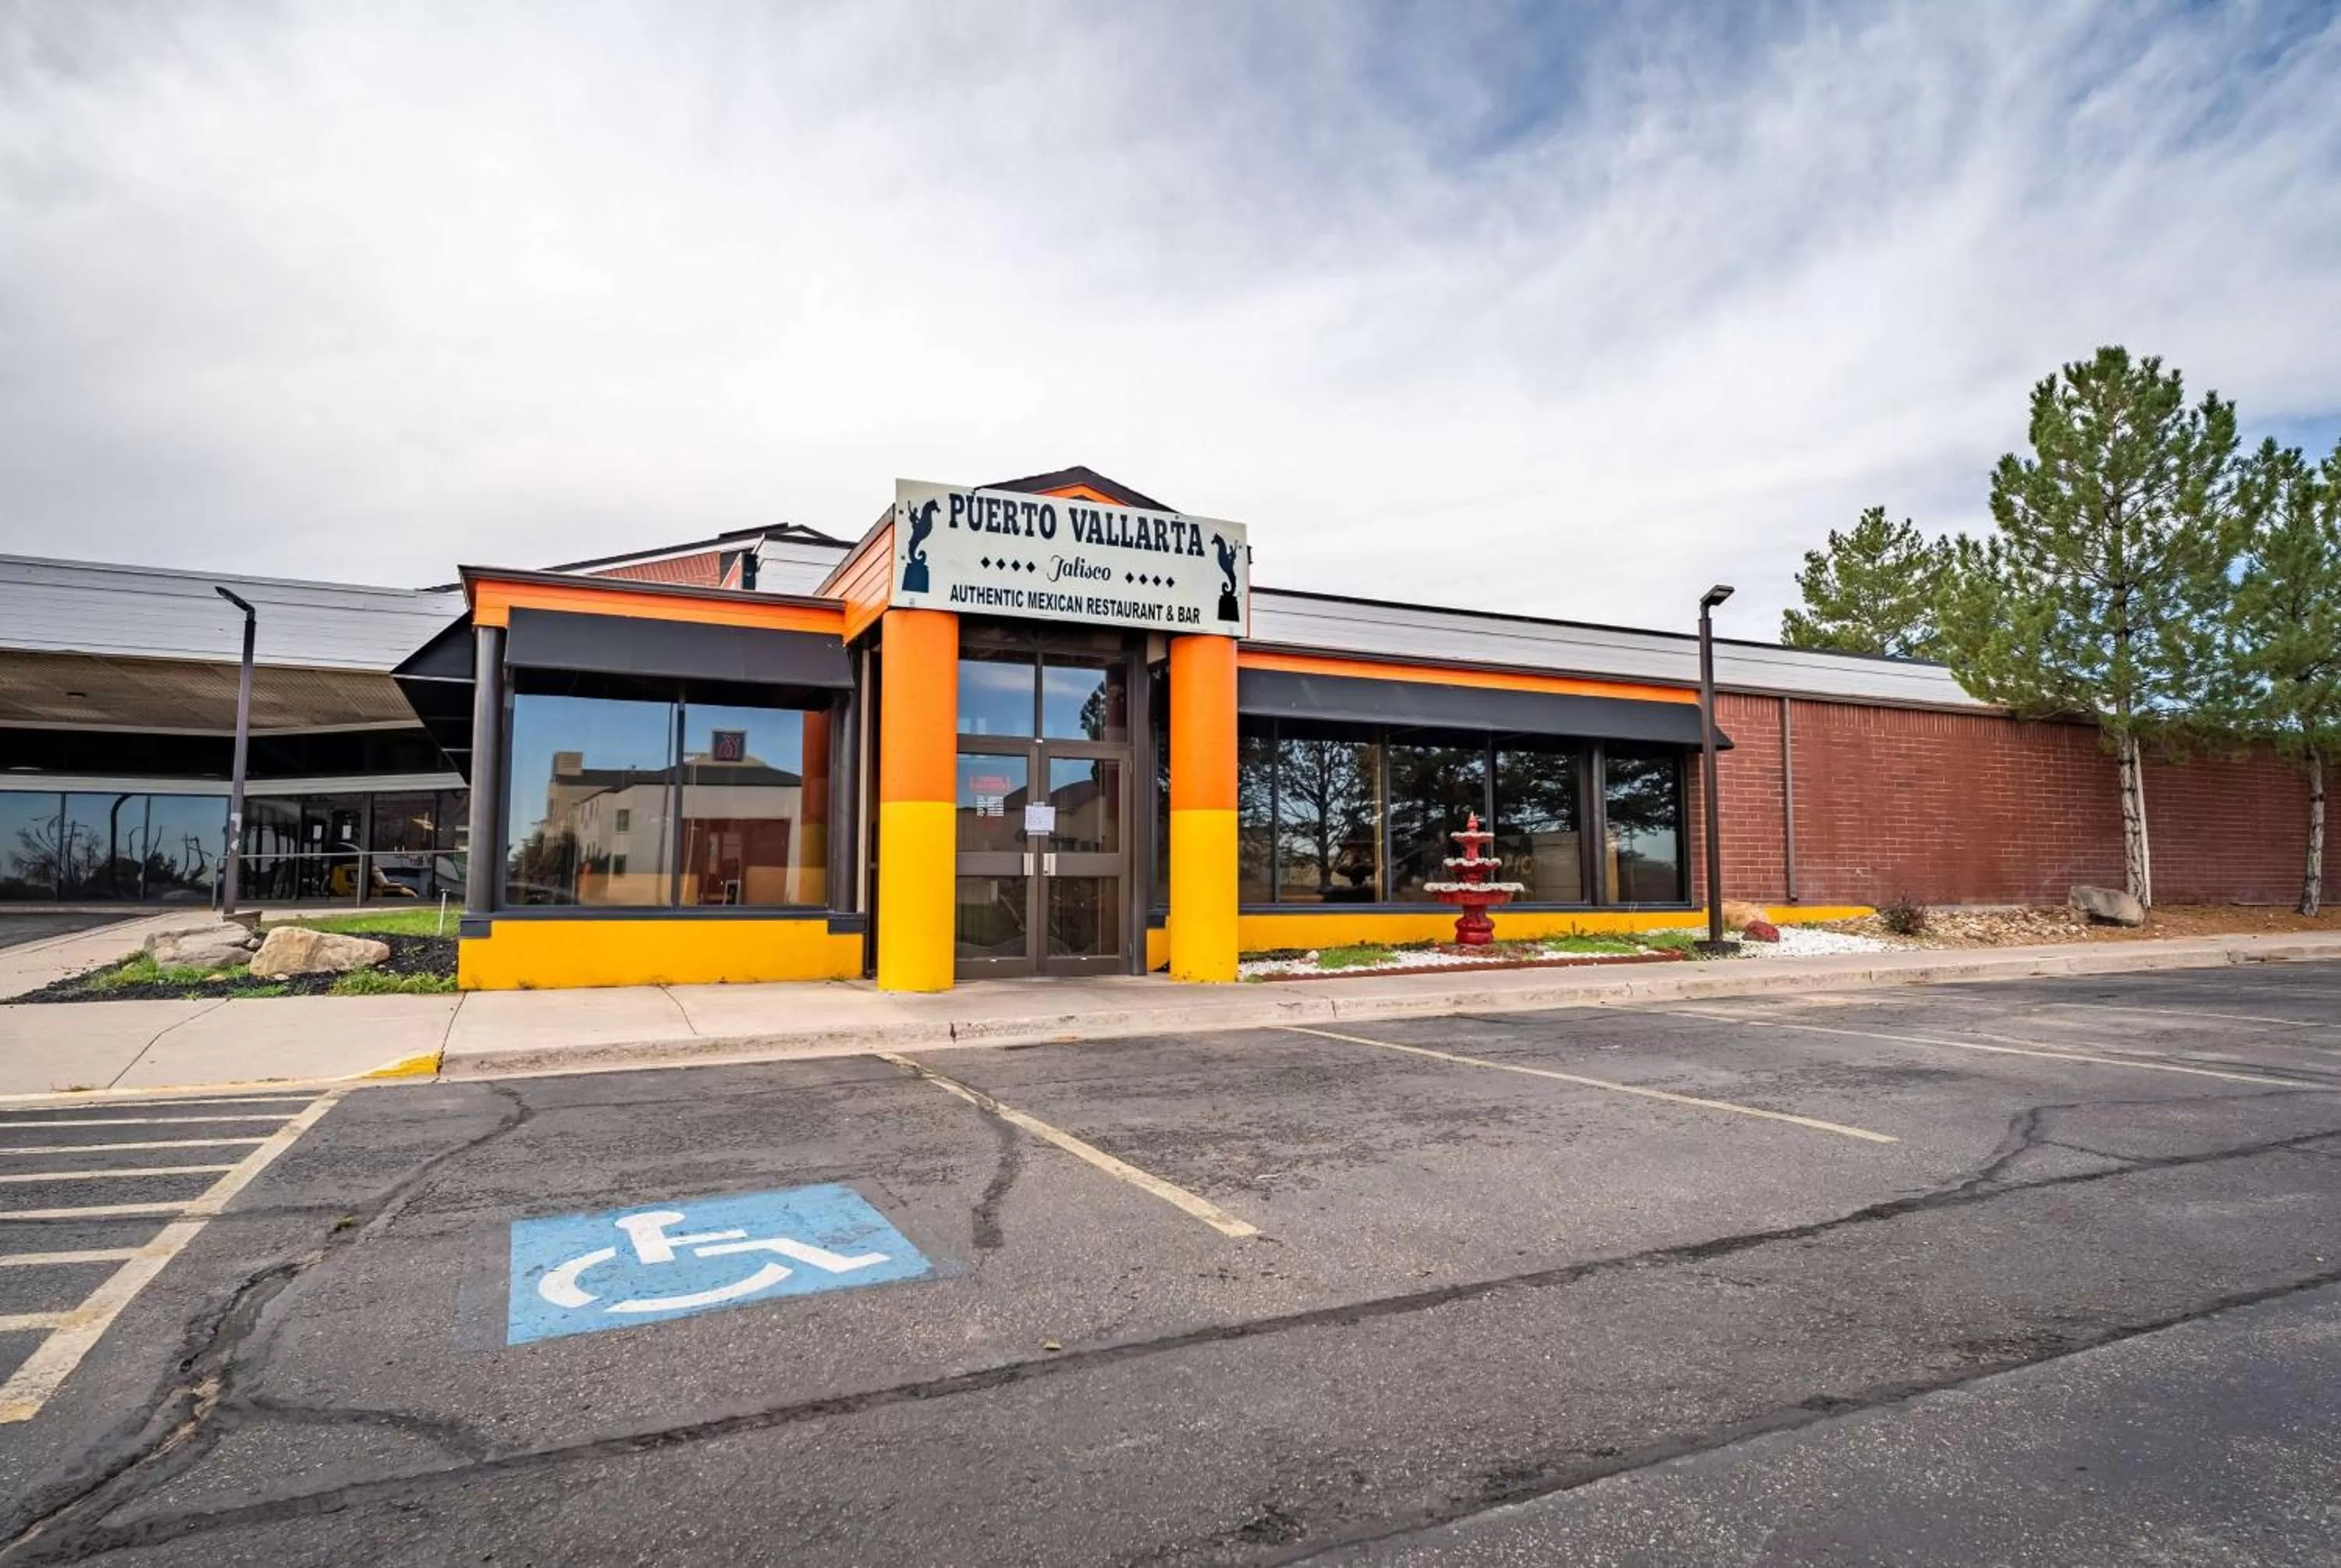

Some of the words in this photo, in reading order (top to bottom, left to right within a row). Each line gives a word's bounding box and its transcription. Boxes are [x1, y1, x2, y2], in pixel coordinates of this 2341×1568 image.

[949, 493, 1057, 540] PUERTO
[1069, 507, 1205, 556] VALLARTA
[1046, 555, 1111, 583] Jalisco
[950, 584, 1024, 608] AUTHENTIC
[1028, 591, 1082, 614] MEXICAN
[1086, 597, 1163, 621] RESTAURANT
[1166, 605, 1174, 622] &
[1178, 606, 1200, 624] BAR
